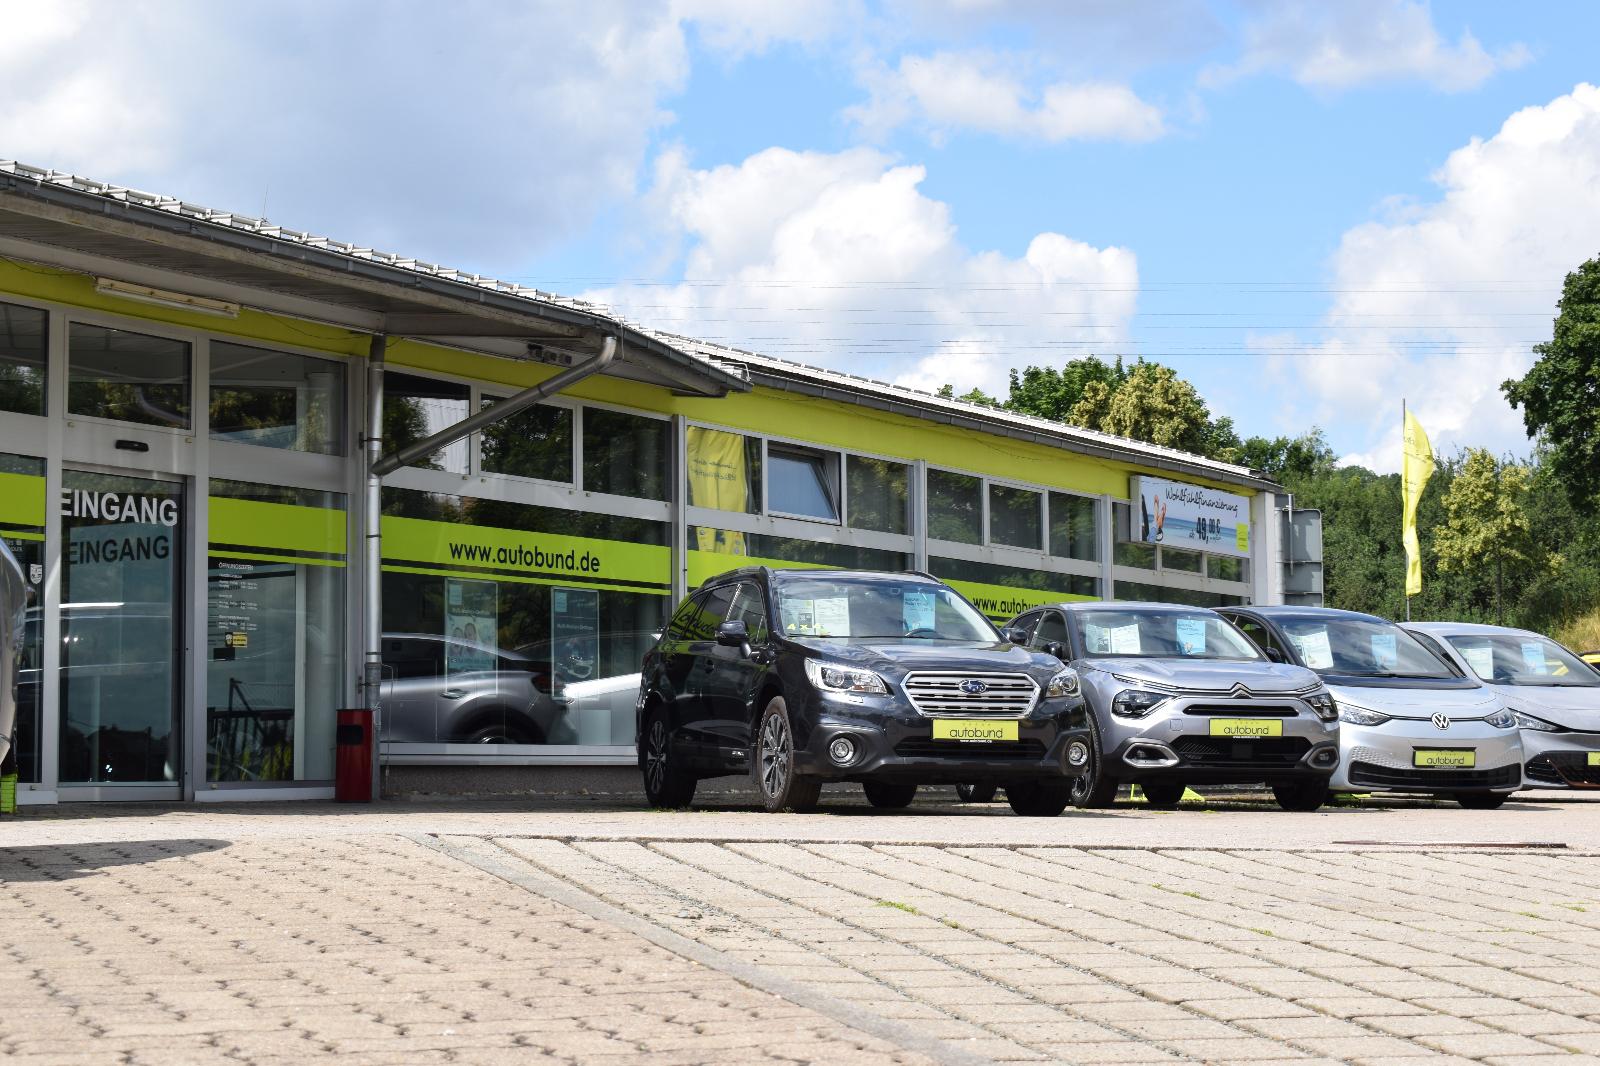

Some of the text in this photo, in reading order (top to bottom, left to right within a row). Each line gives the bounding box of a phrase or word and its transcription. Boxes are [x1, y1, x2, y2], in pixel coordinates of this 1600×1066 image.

[60, 488, 178, 527] EINGANG
[449, 543, 600, 572] www.autobund.de
[949, 728, 1003, 738] autobund
[1223, 721, 1269, 735] autobund
[1426, 756, 1464, 765] autobund
